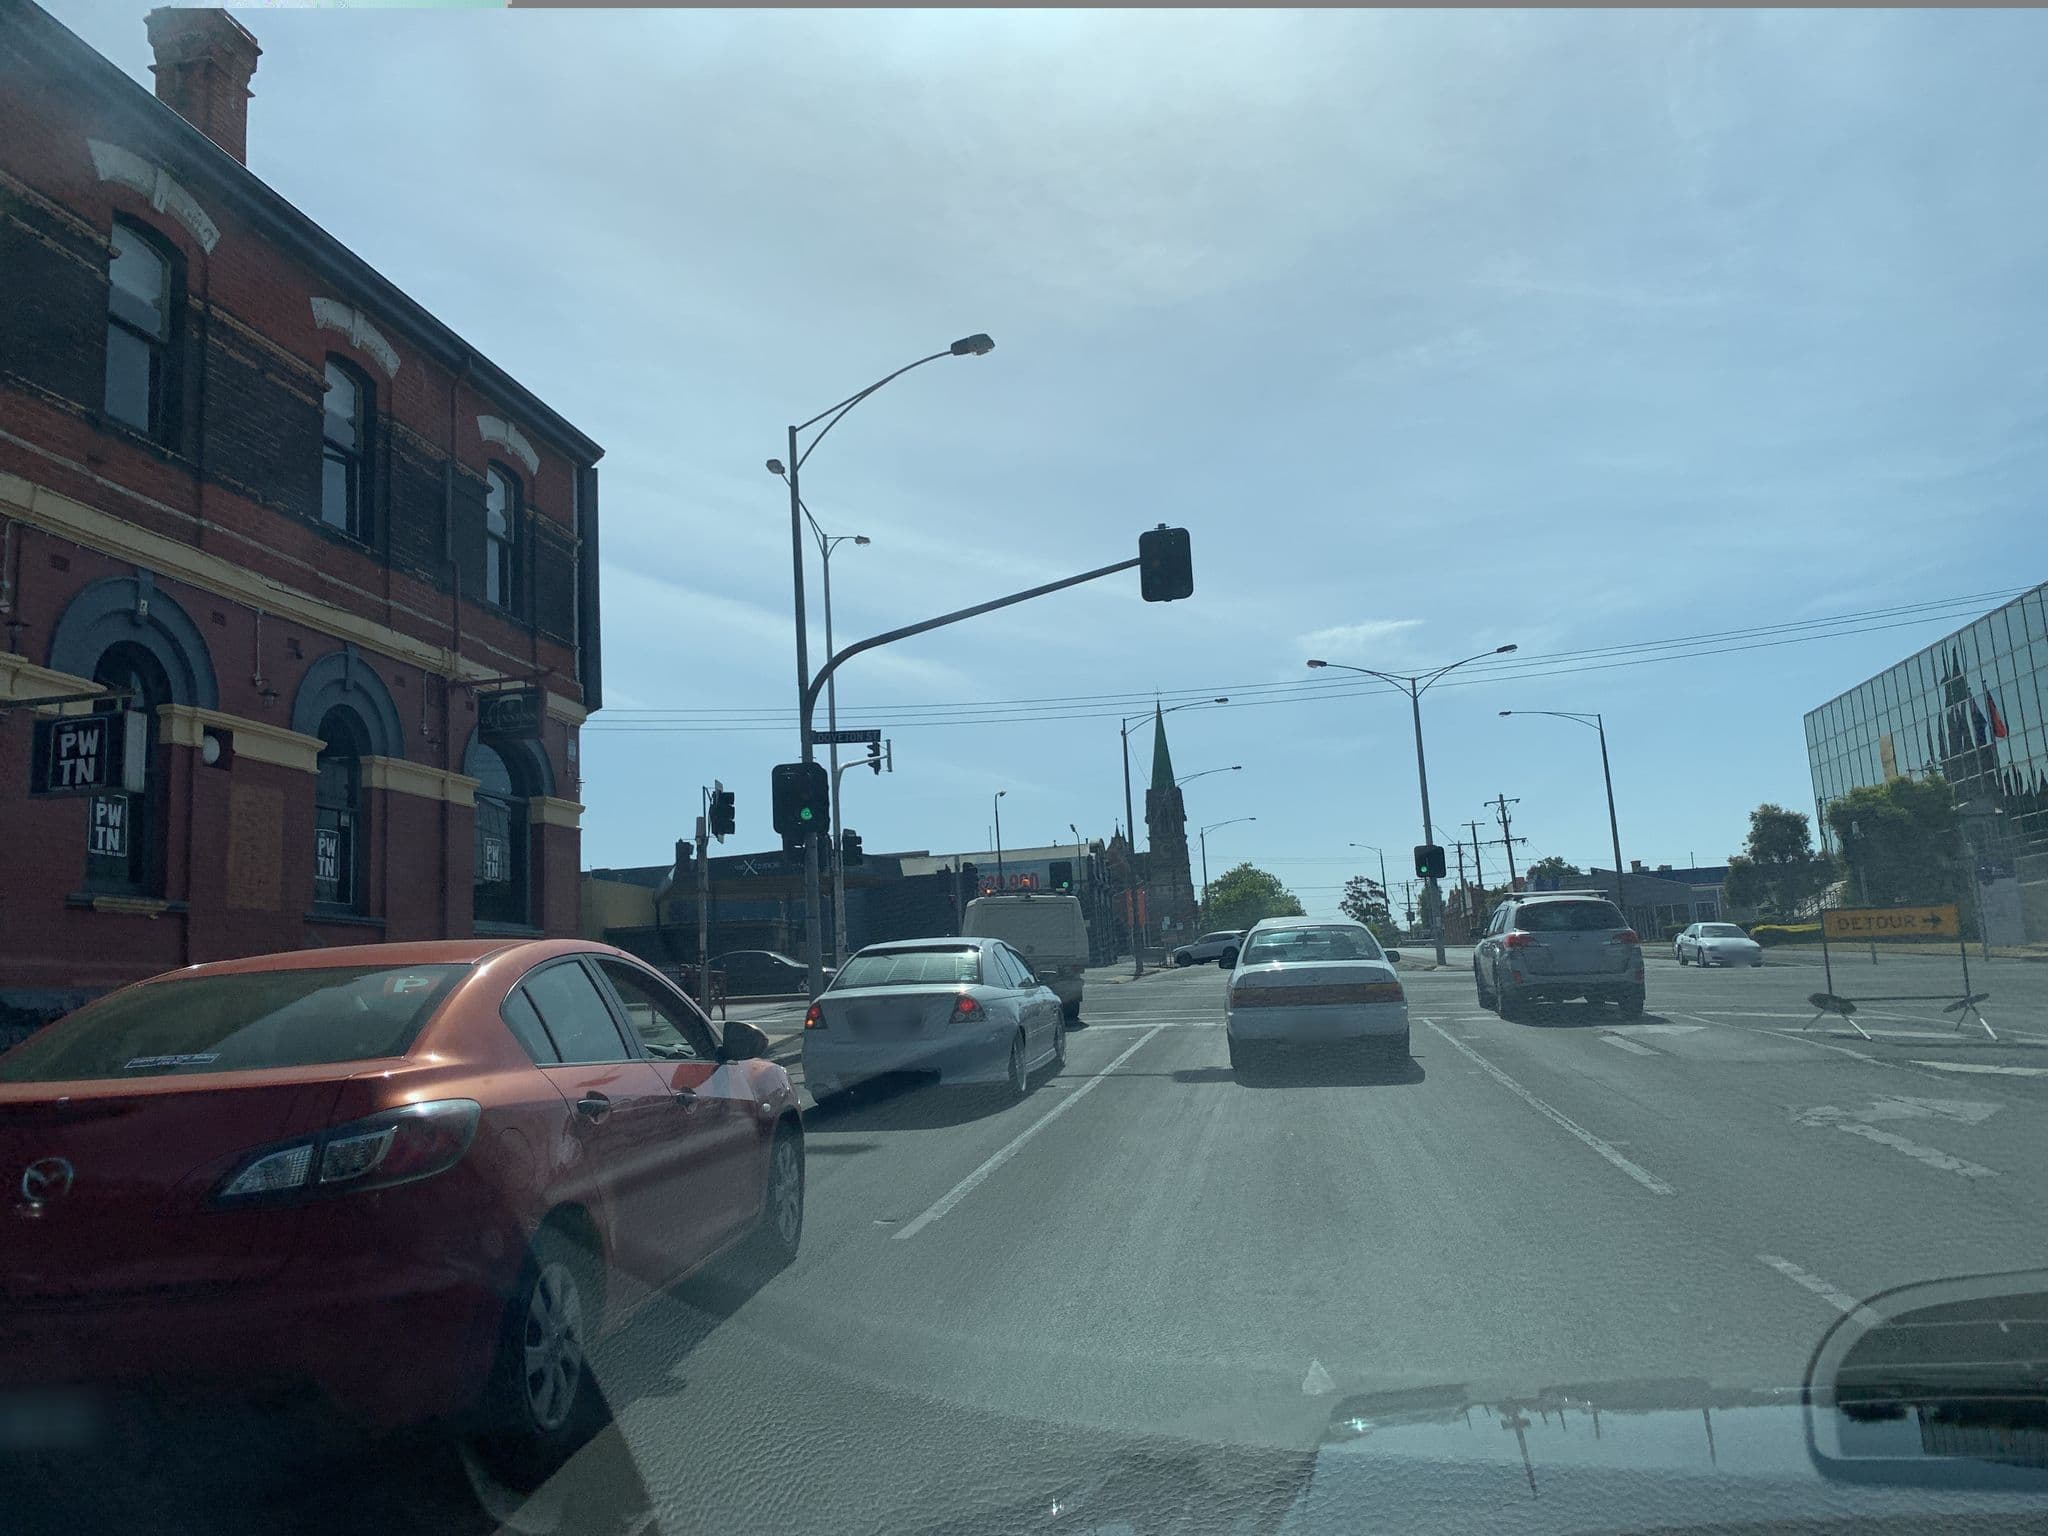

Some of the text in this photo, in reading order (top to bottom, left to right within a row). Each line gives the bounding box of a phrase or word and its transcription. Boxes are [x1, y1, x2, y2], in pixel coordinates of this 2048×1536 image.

[60, 729, 99, 757] PW
[59, 757, 95, 785] TN
[96, 803, 122, 826] PW
[95, 826, 120, 850] TN
[318, 837, 336, 857] PW
[317, 857, 334, 876] TN
[1837, 915, 1916, 930] DETOUR
